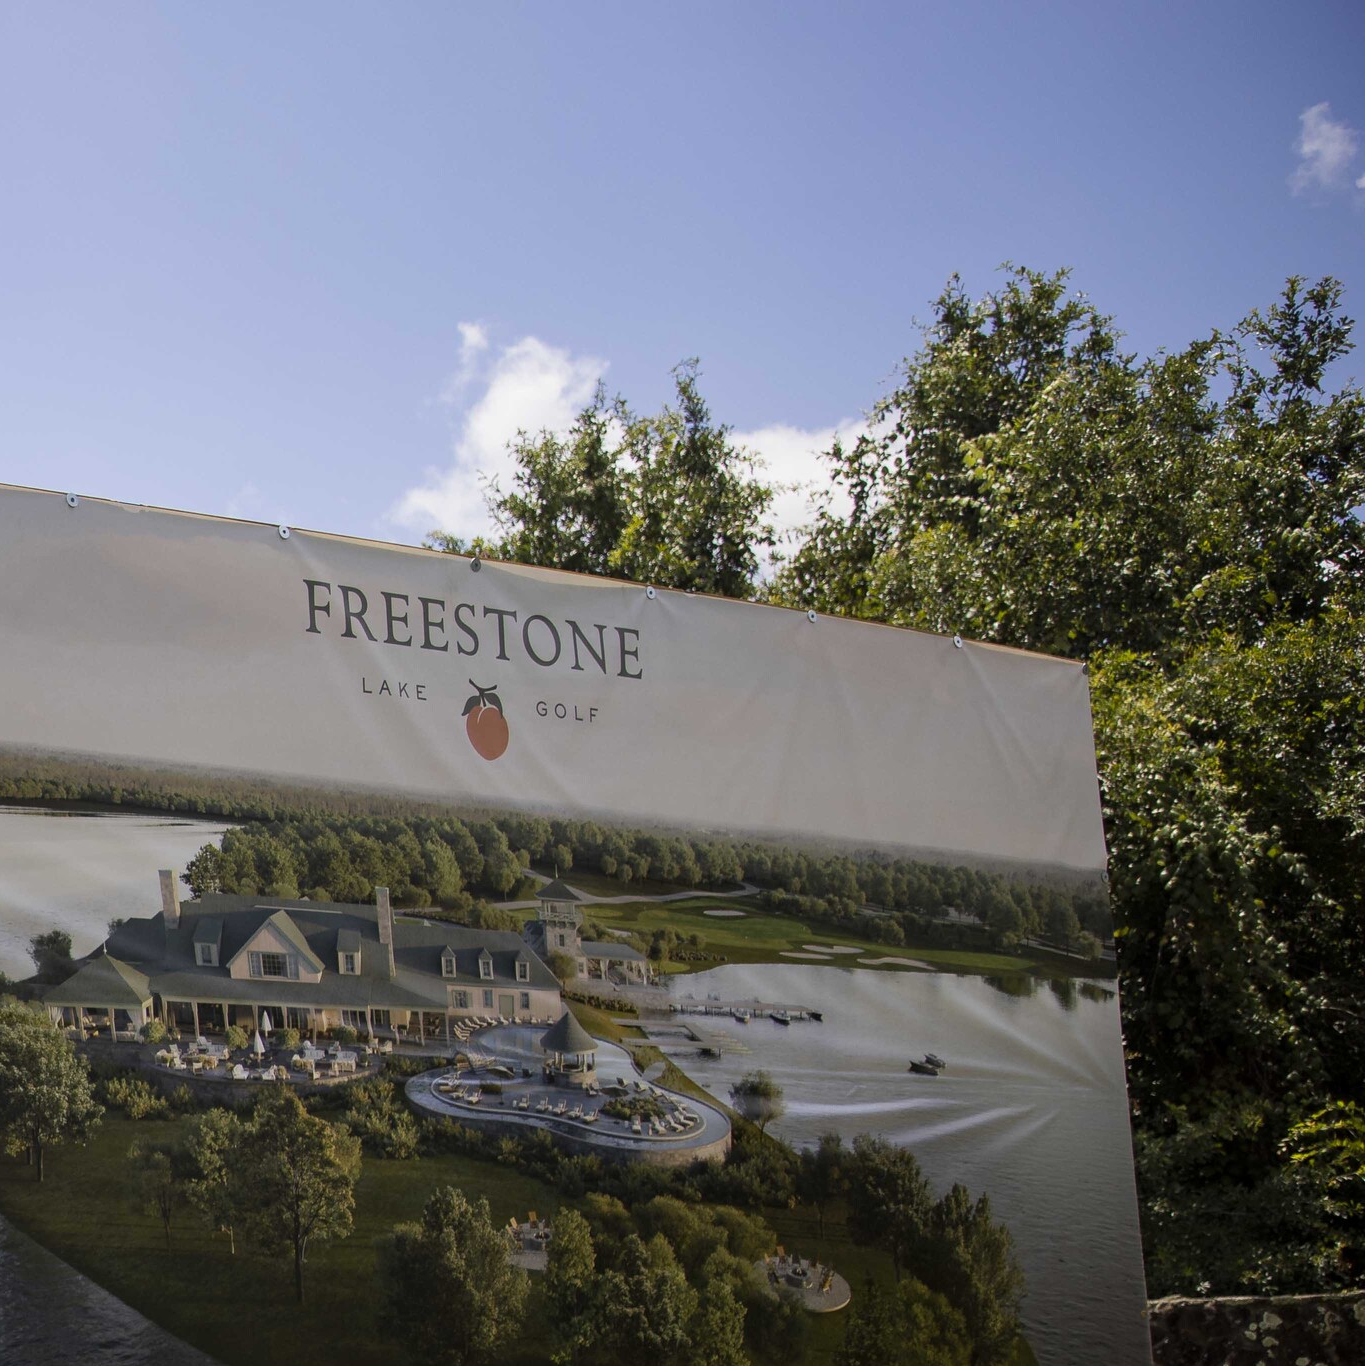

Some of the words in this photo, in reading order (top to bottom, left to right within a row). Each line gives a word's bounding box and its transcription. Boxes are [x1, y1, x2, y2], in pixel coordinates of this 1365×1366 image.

[302, 578, 643, 680] FREESTONE
[362, 677, 427, 701] LAKE
[536, 700, 599, 723] GOLF
